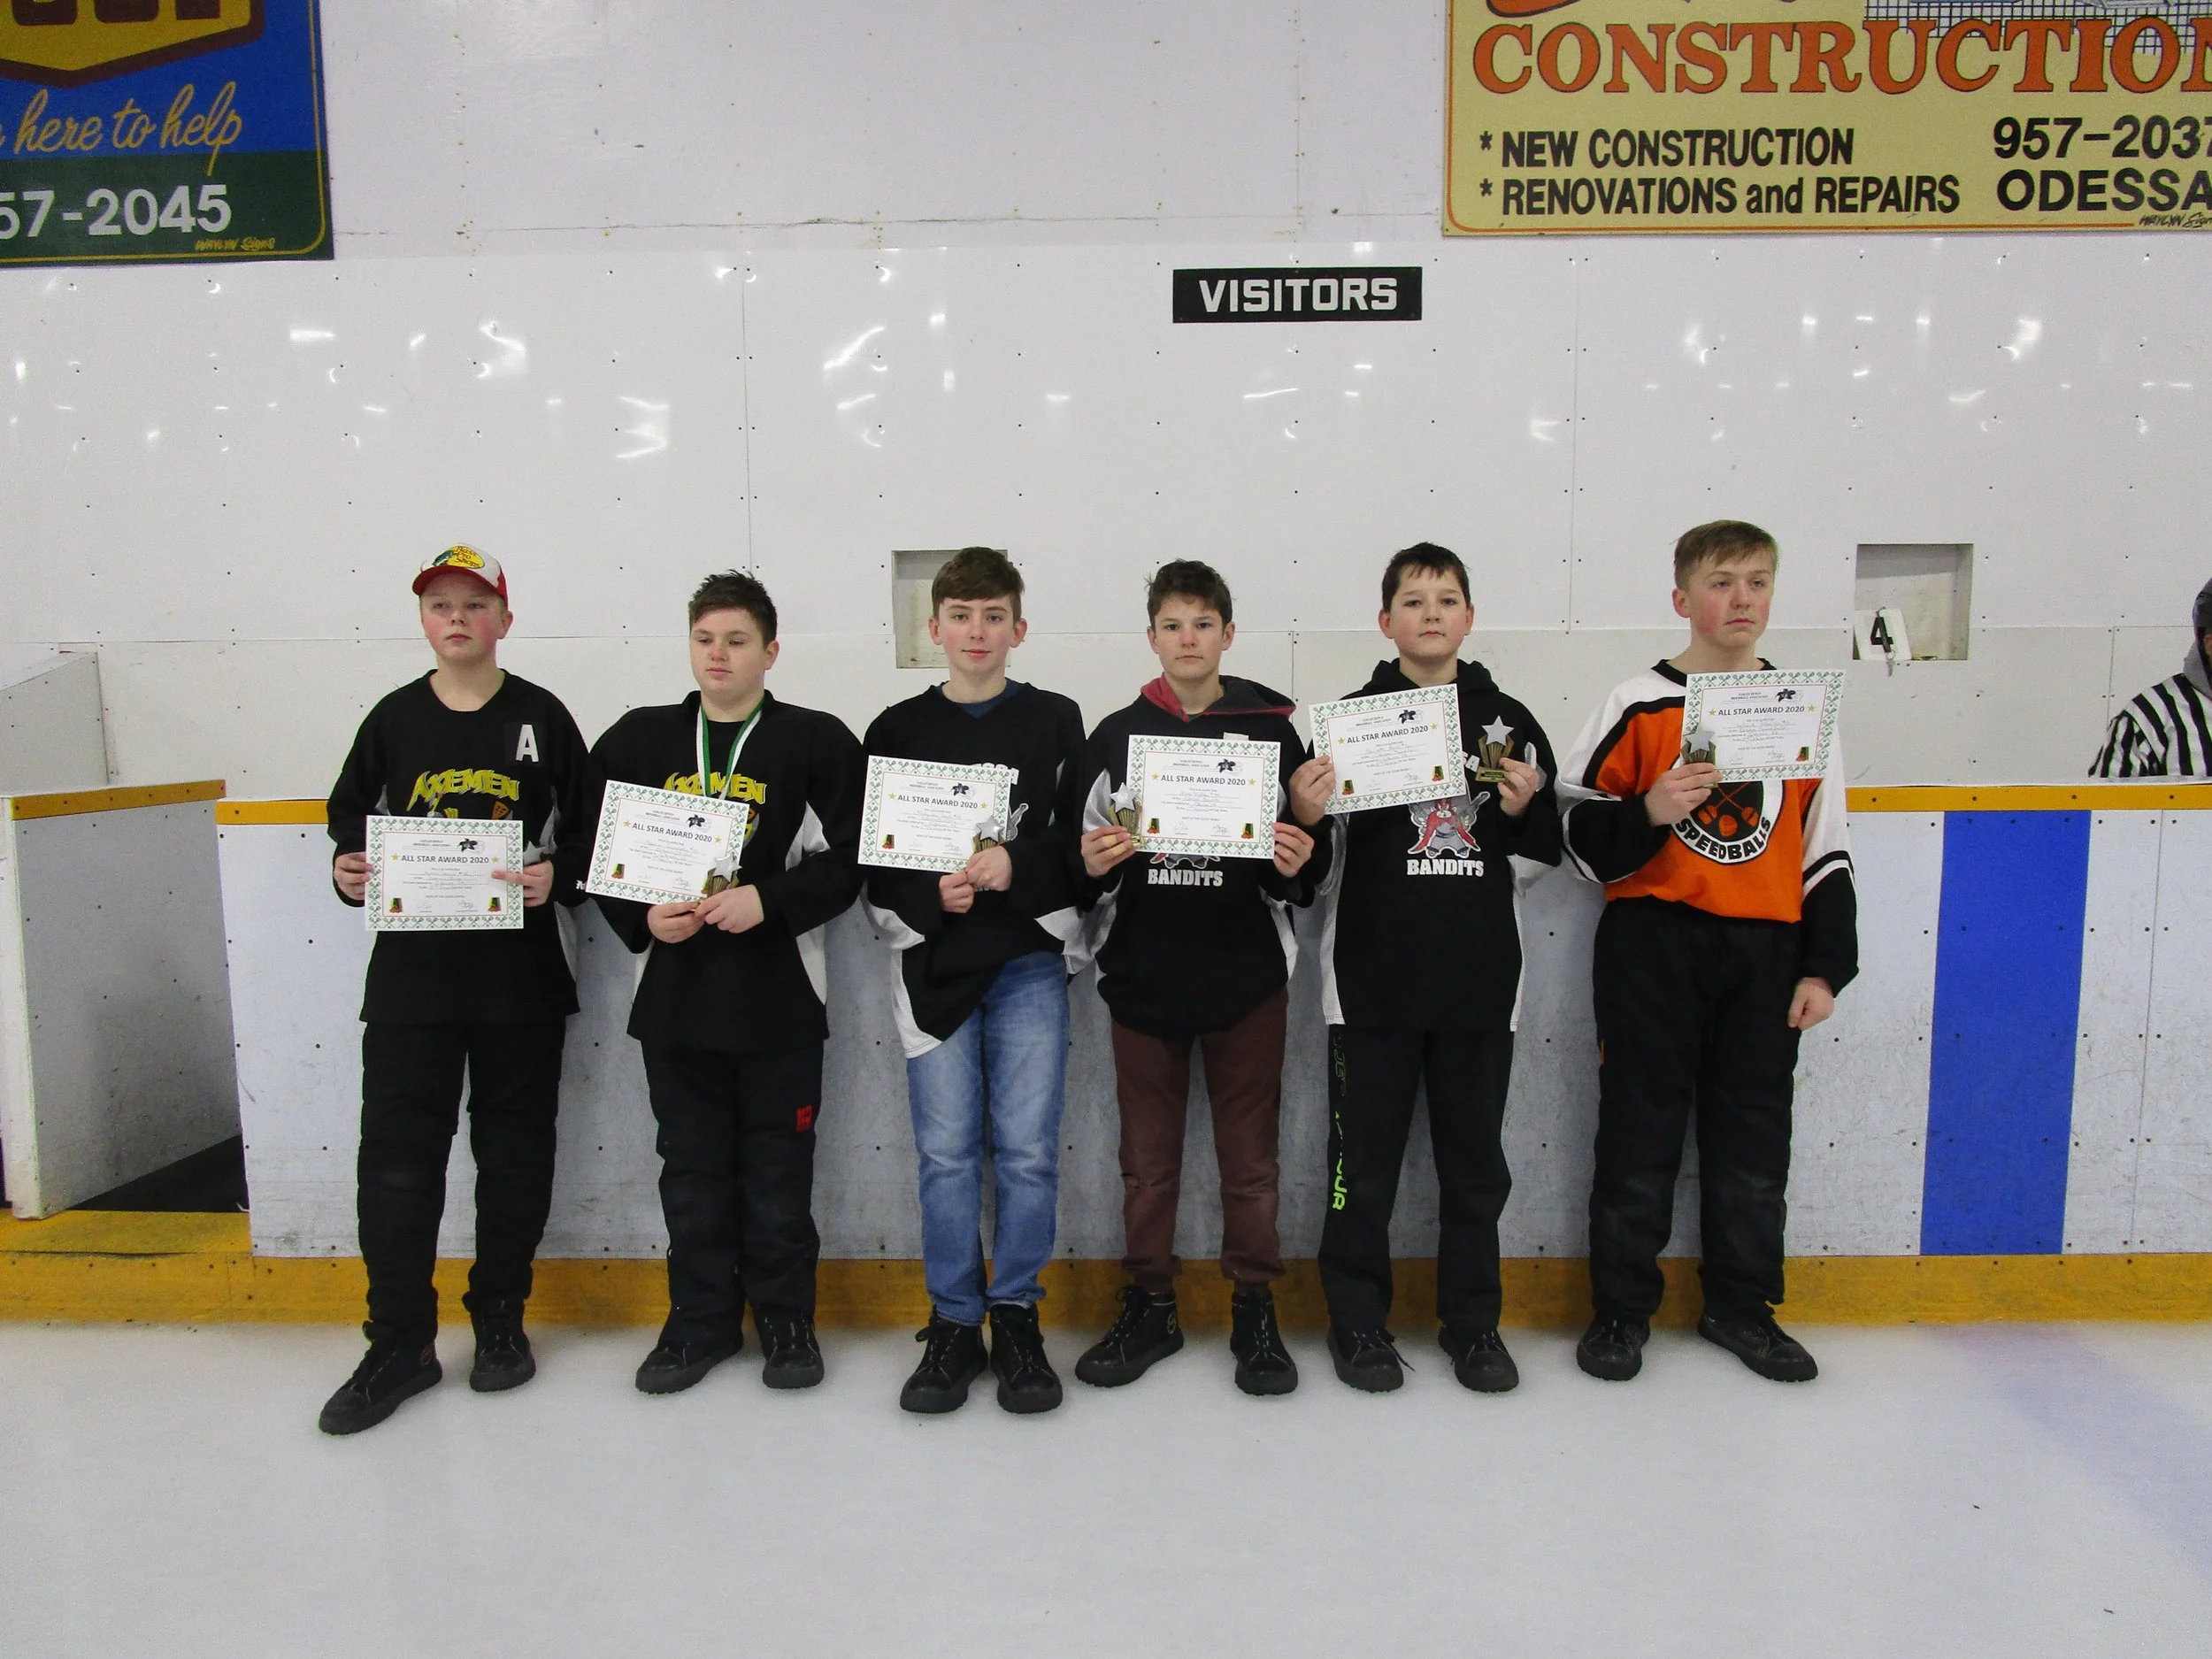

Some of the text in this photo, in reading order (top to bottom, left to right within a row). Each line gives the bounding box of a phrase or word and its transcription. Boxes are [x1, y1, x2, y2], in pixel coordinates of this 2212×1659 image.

[13, 88, 104, 155] here
[113, 98, 157, 150] to
[160, 81, 243, 177] help
[1502, 127, 1855, 168] NEW CONSTRUCTION
[1502, 174, 1960, 215] RENOVATIONS and REPAIRS
[1997, 166, 2212, 212] ODESSA
[1199, 277, 1397, 312] VISITORS
[1870, 617, 1894, 653] 4
[1754, 706, 1784, 715] AWARD
[516, 724, 540, 762] A
[1347, 725, 1429, 744] ALL STAR AWARD 2020
[406, 768, 520, 811] AXEMEN
[1196, 776, 1225, 785] AWARD
[912, 795, 930, 804] STAR
[931, 797, 959, 807] AWARD
[632, 822, 713, 843] ALL STAR AWARD 2020
[1675, 817, 1771, 860] SPEEDBALLS
[1148, 869, 1224, 887] BANDITS
[1406, 859, 1484, 877] BANDITS
